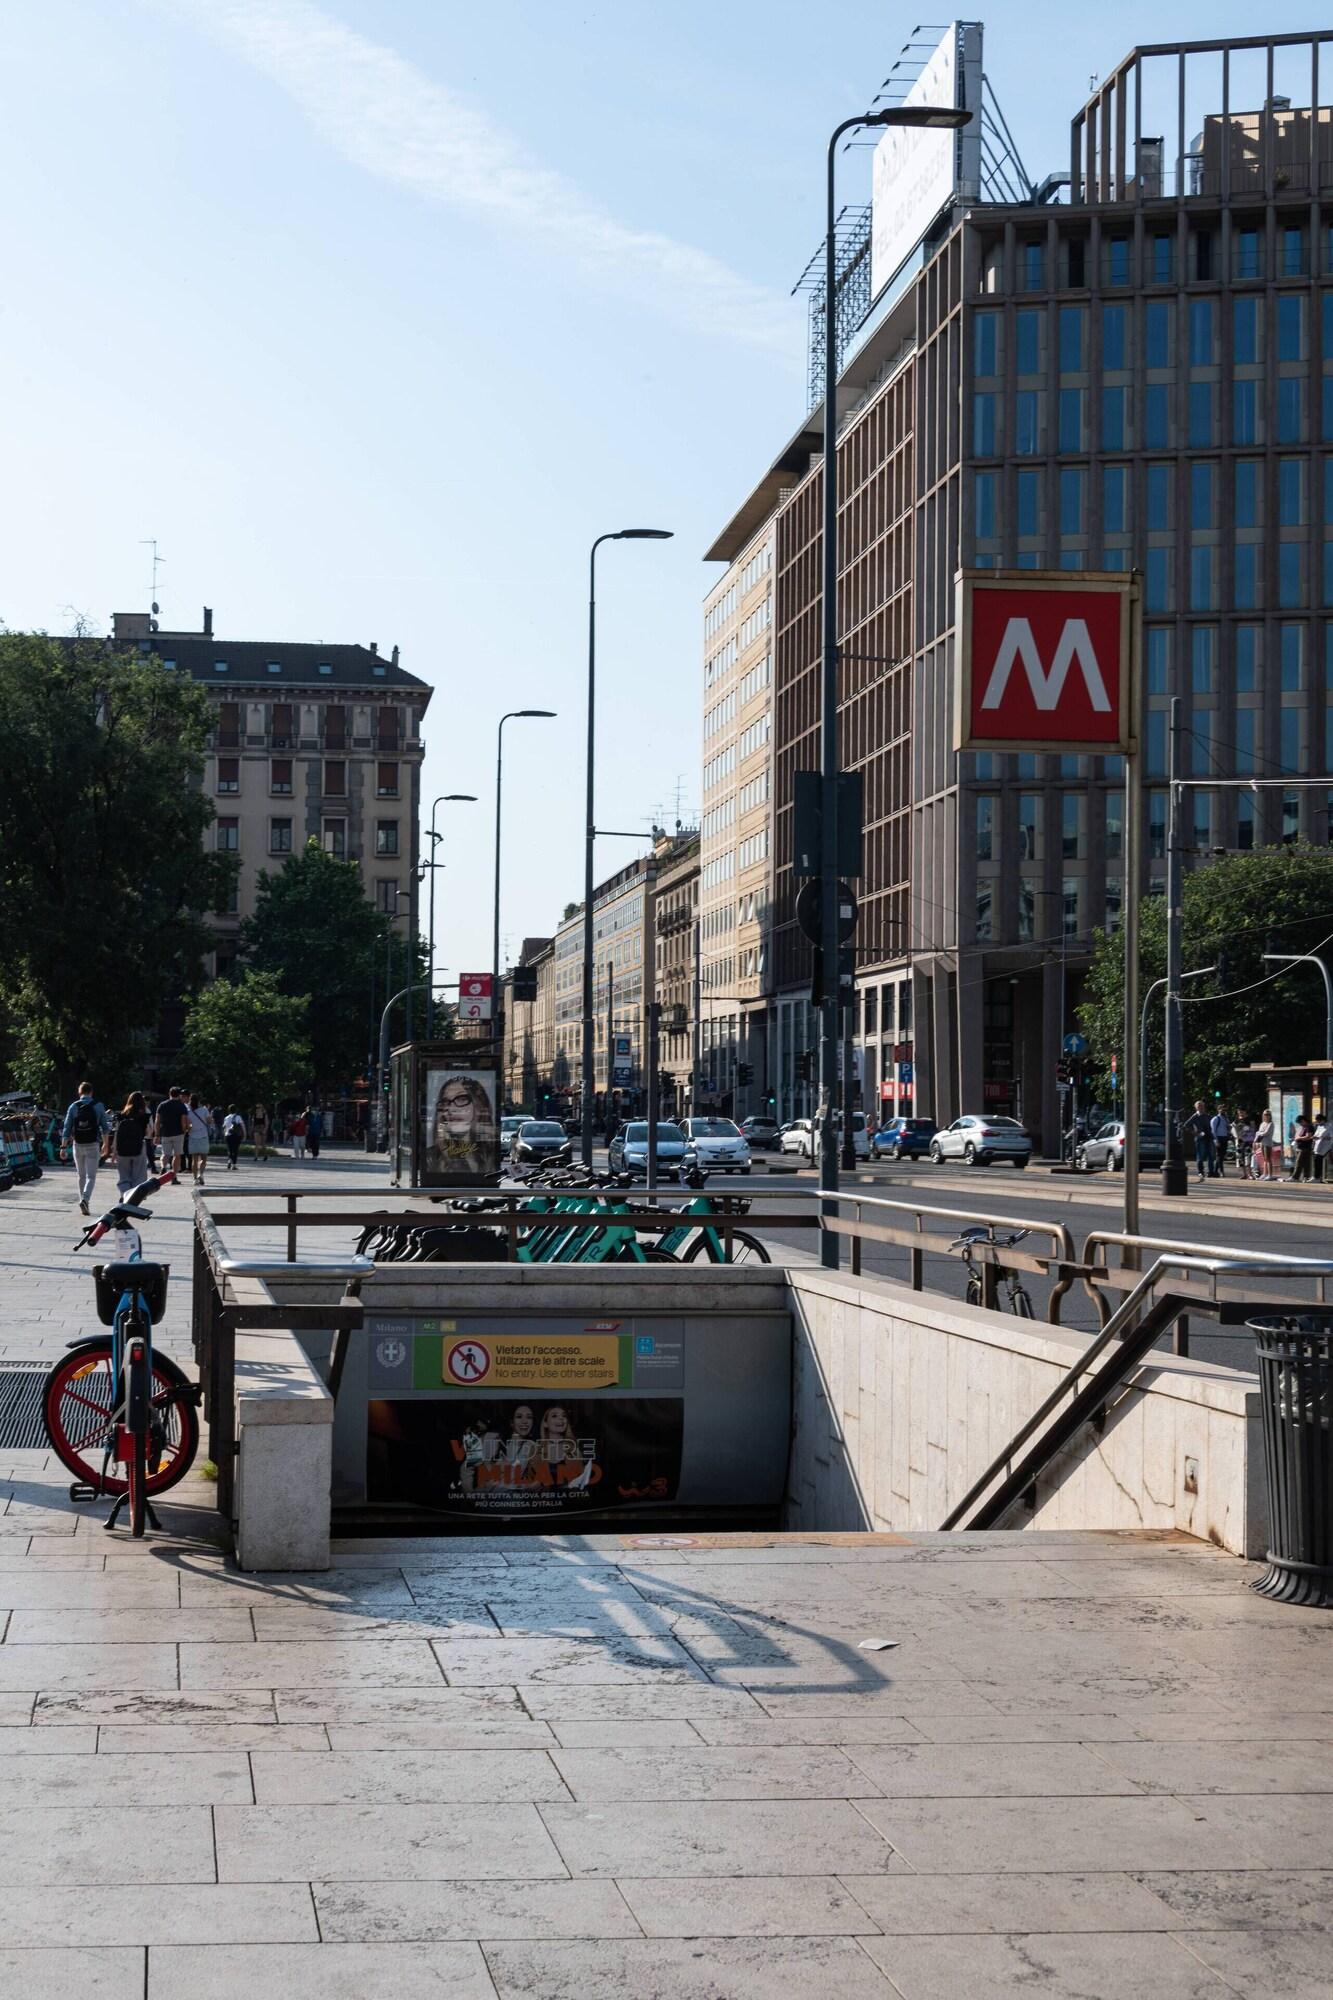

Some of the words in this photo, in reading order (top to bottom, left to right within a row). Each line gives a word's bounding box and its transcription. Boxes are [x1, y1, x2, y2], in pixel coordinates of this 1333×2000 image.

[981, 617, 1113, 712] M
[902, 1064, 911, 1073] P
[376, 1323, 407, 1333] Milano
[496, 1345, 530, 1355] Vietato
[533, 1345, 583, 1355] l'accesso.
[496, 1356, 541, 1365] Utilizzare
[543, 1356, 552, 1365] le
[555, 1356, 577, 1365] altre
[579, 1356, 605, 1365] scale
[496, 1369, 509, 1378] No
[539, 1369, 559, 1378] Use
[561, 1369, 585, 1378] other
[589, 1368, 614, 1378] stairs
